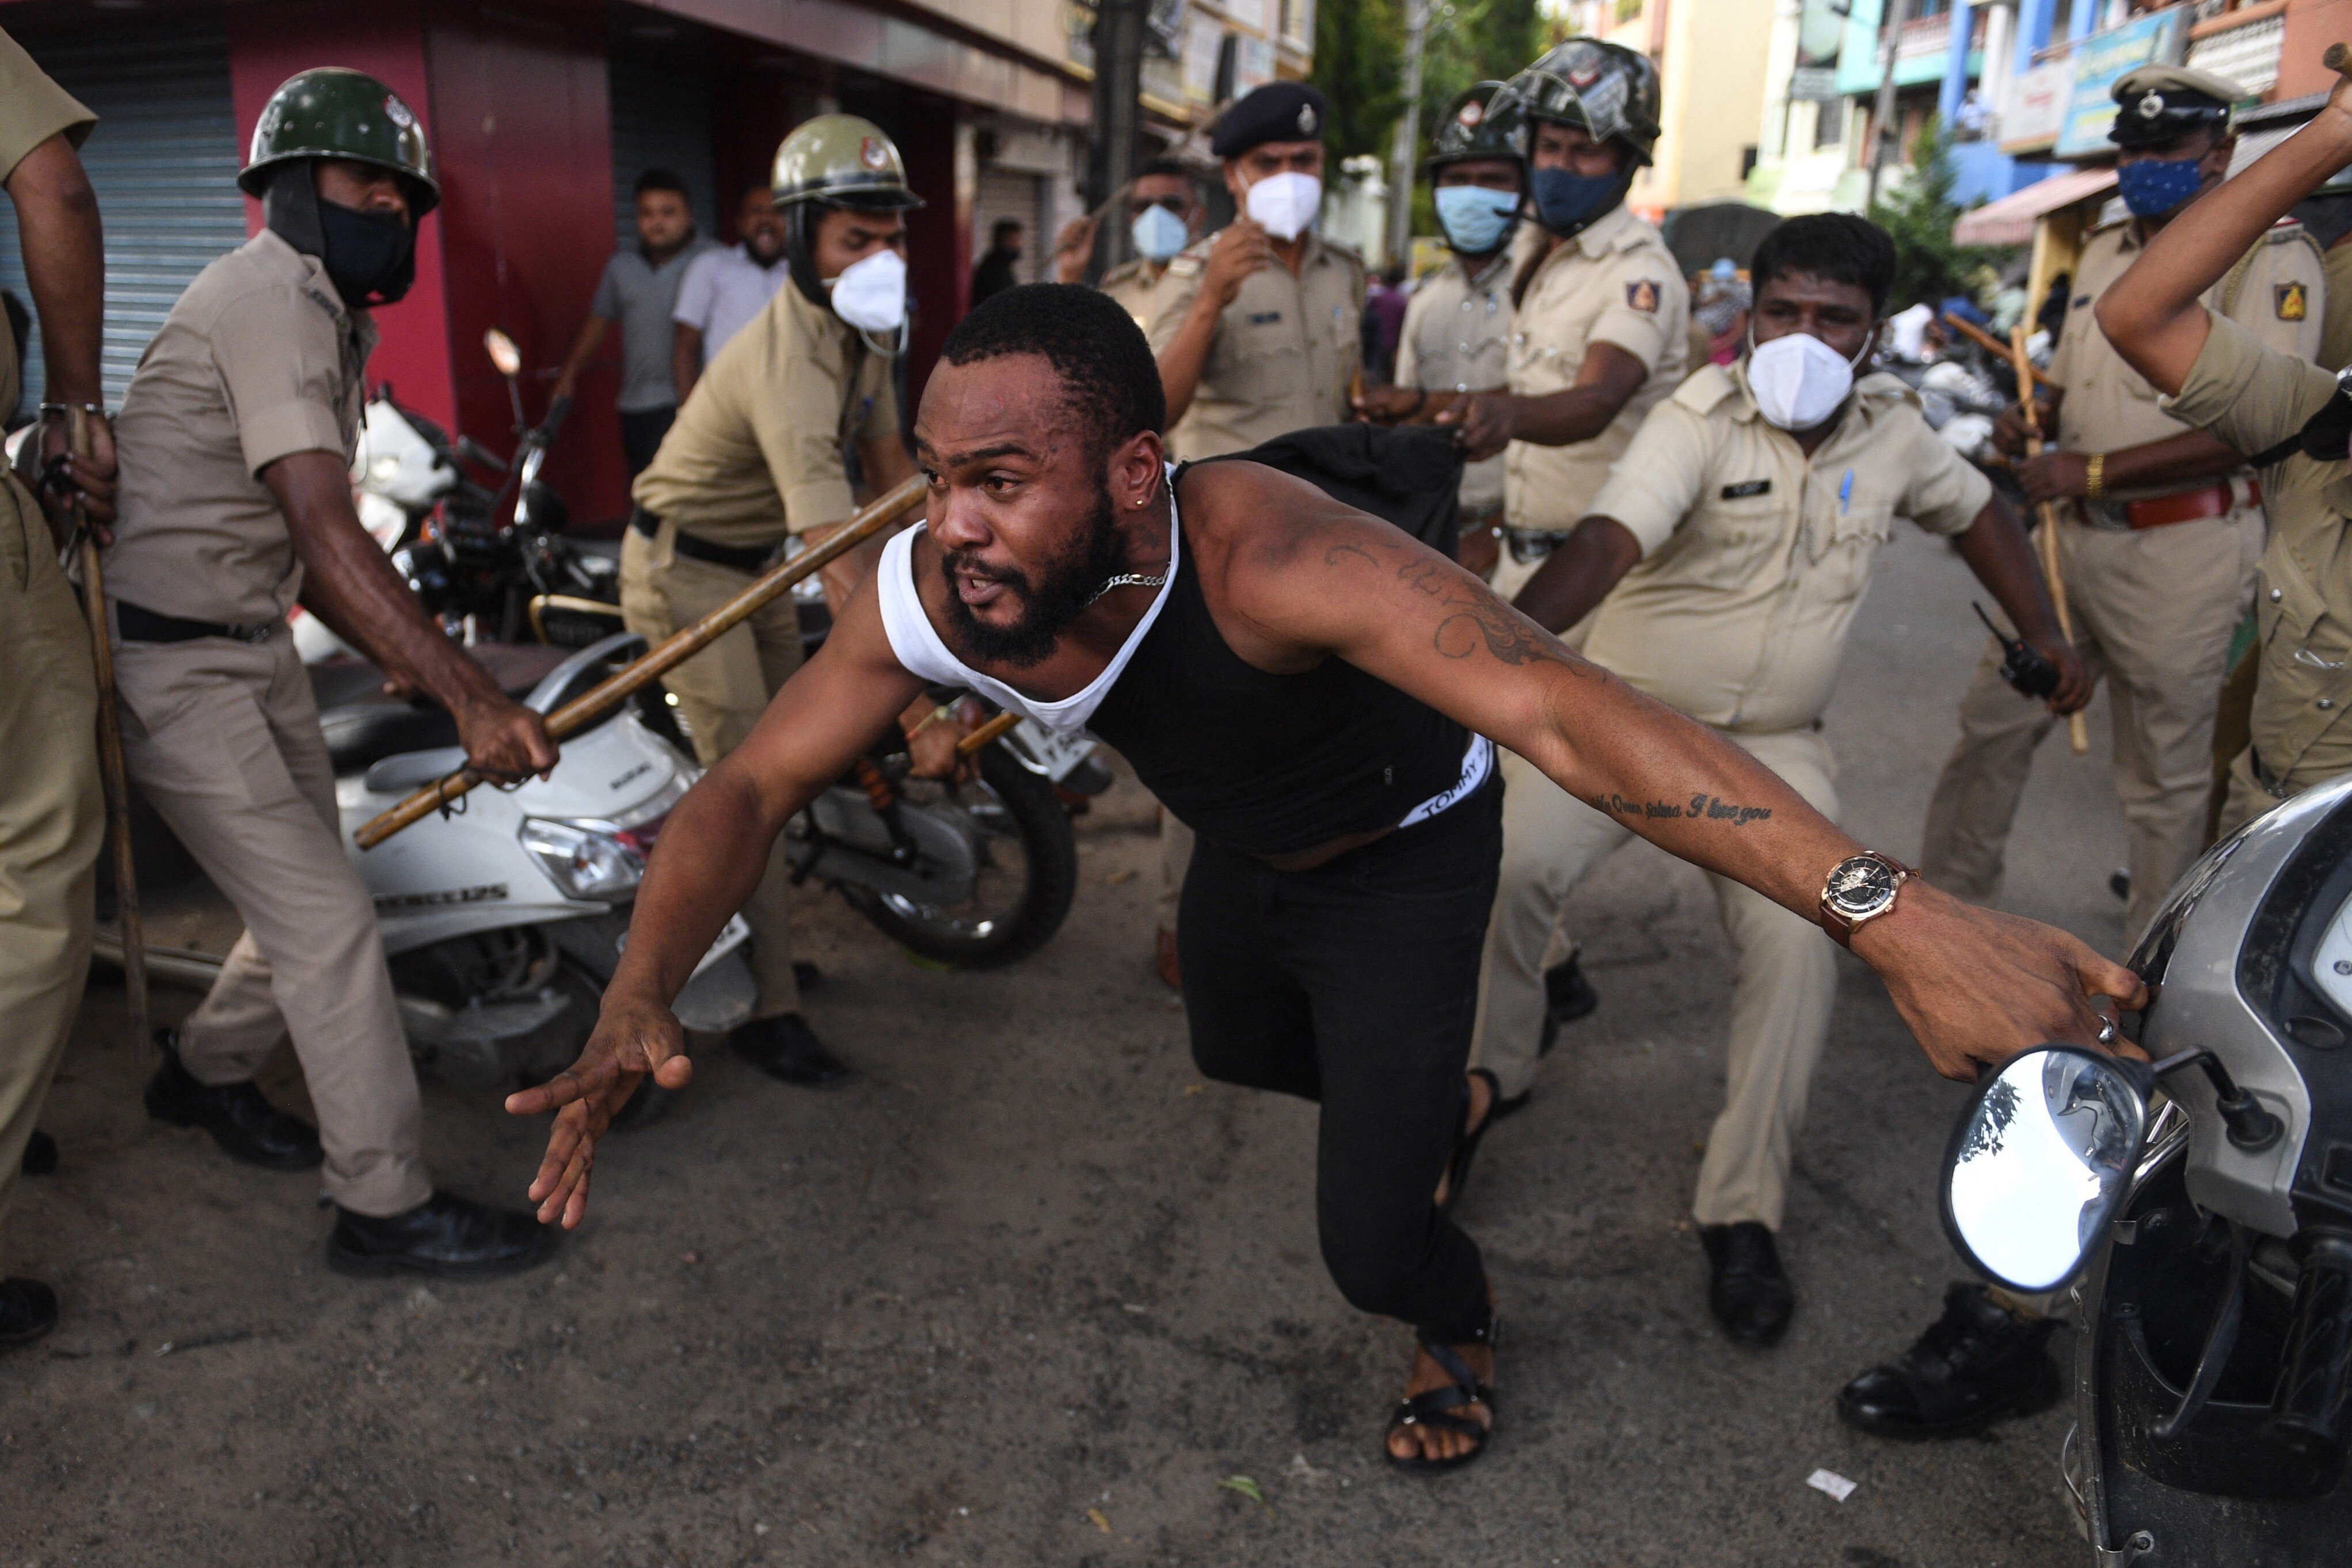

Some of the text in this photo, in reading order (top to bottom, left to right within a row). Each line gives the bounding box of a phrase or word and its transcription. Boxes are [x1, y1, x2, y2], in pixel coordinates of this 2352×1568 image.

[1421, 759, 1477, 816] TOMMY
[1686, 794, 1708, 818] I
[1733, 807, 1772, 826] you
